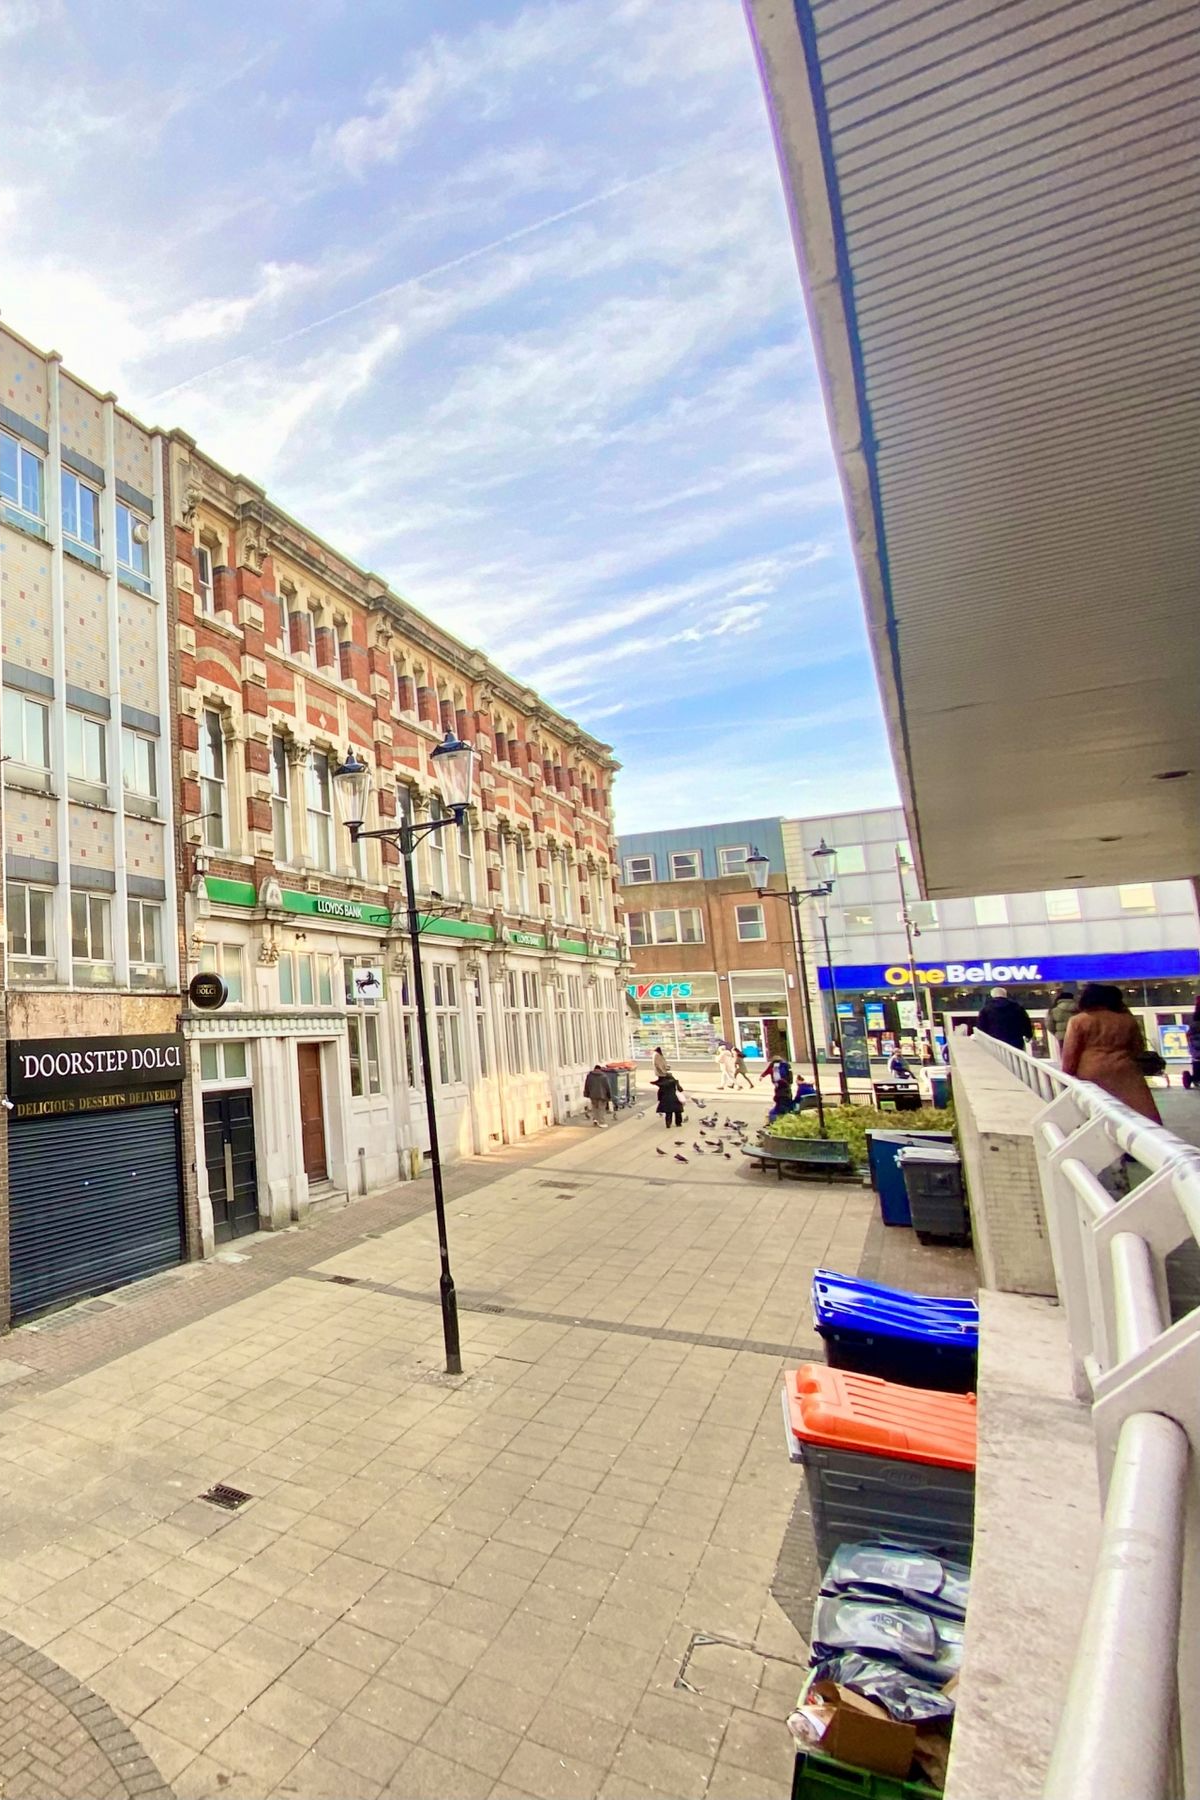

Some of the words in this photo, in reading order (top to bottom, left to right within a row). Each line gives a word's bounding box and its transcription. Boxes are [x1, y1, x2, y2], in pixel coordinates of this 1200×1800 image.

[317, 900, 344, 915] LLOYDS
[344, 904, 363, 918] BANK
[131, 1046, 182, 1070] DOLCI
[17, 1100, 75, 1117] DELICIOUS
[79, 1093, 126, 1109] DESSERTS
[129, 1089, 177, 1104] DELIVERED
